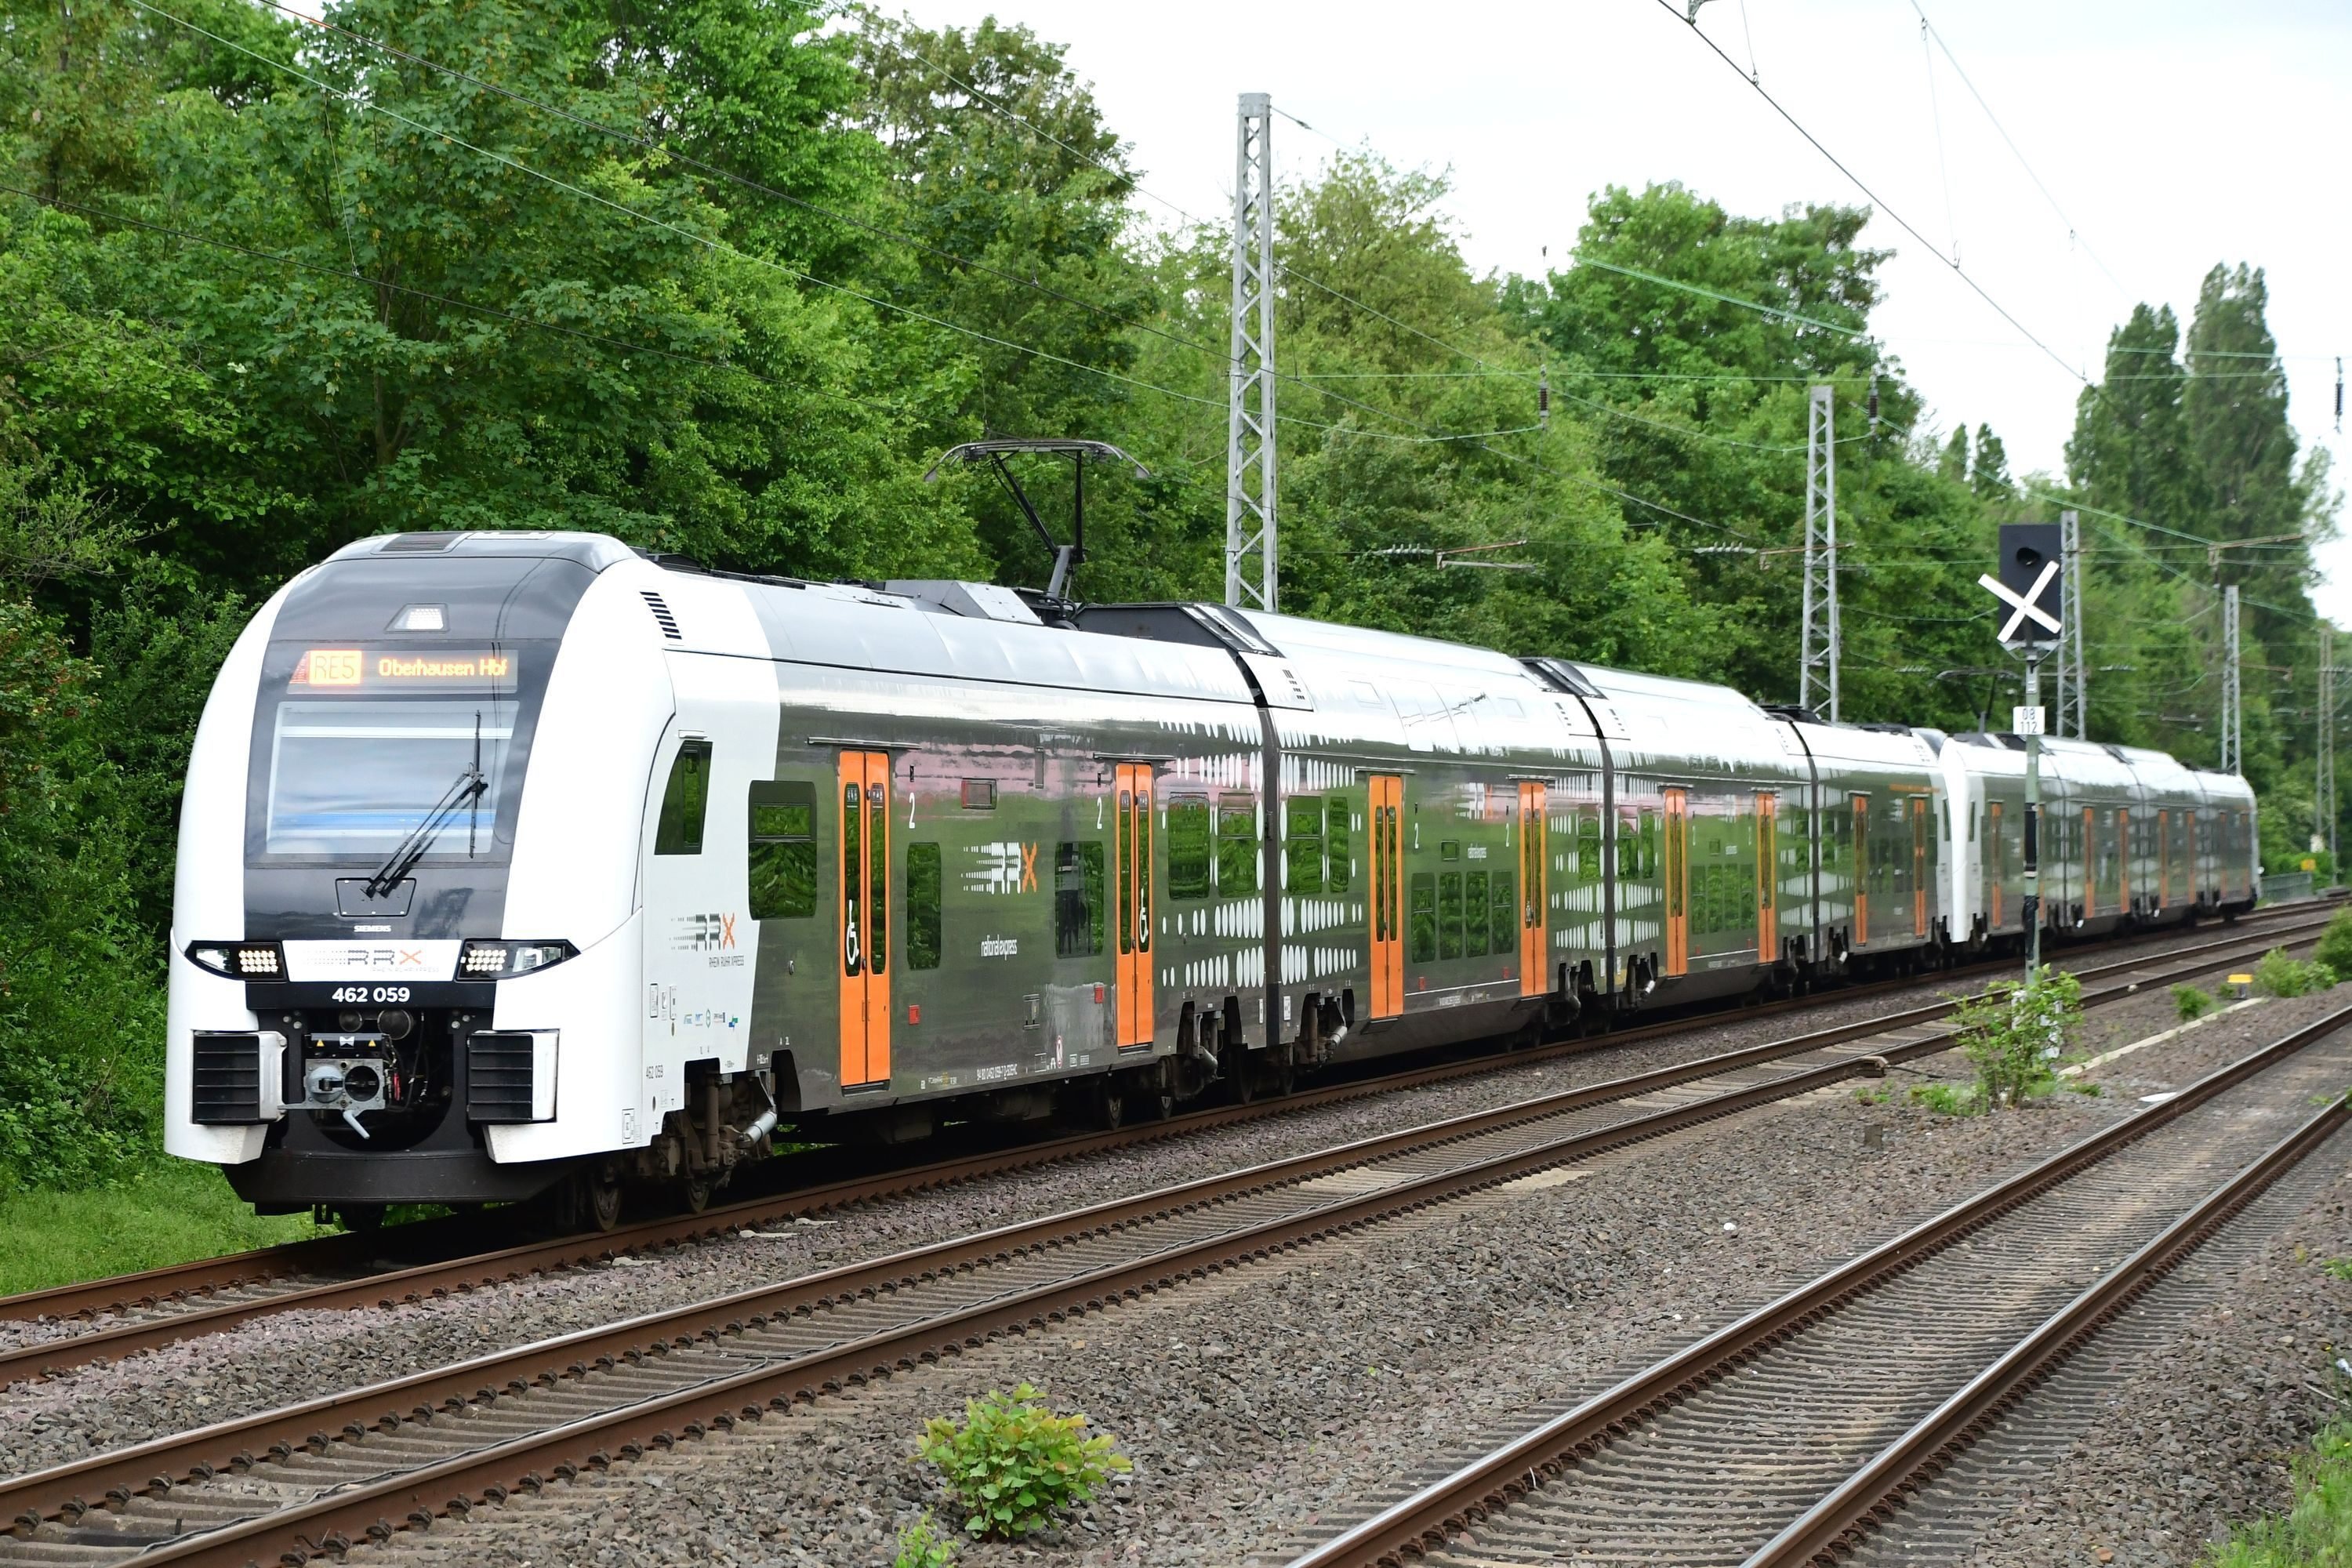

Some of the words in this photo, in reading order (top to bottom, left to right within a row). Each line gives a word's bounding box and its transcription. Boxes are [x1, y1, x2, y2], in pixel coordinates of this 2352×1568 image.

[314, 655, 355, 680] RE5
[379, 659, 474, 677] Oberhausen
[479, 658, 507, 677] Hbf
[2023, 708, 2035, 720] 08
[2020, 721, 2038, 734] 112
[909, 792, 916, 829] 2
[1097, 797, 1103, 829] 2
[353, 924, 392, 933] SIEMENS
[332, 987, 368, 1003] 462
[372, 987, 410, 1003] 059
